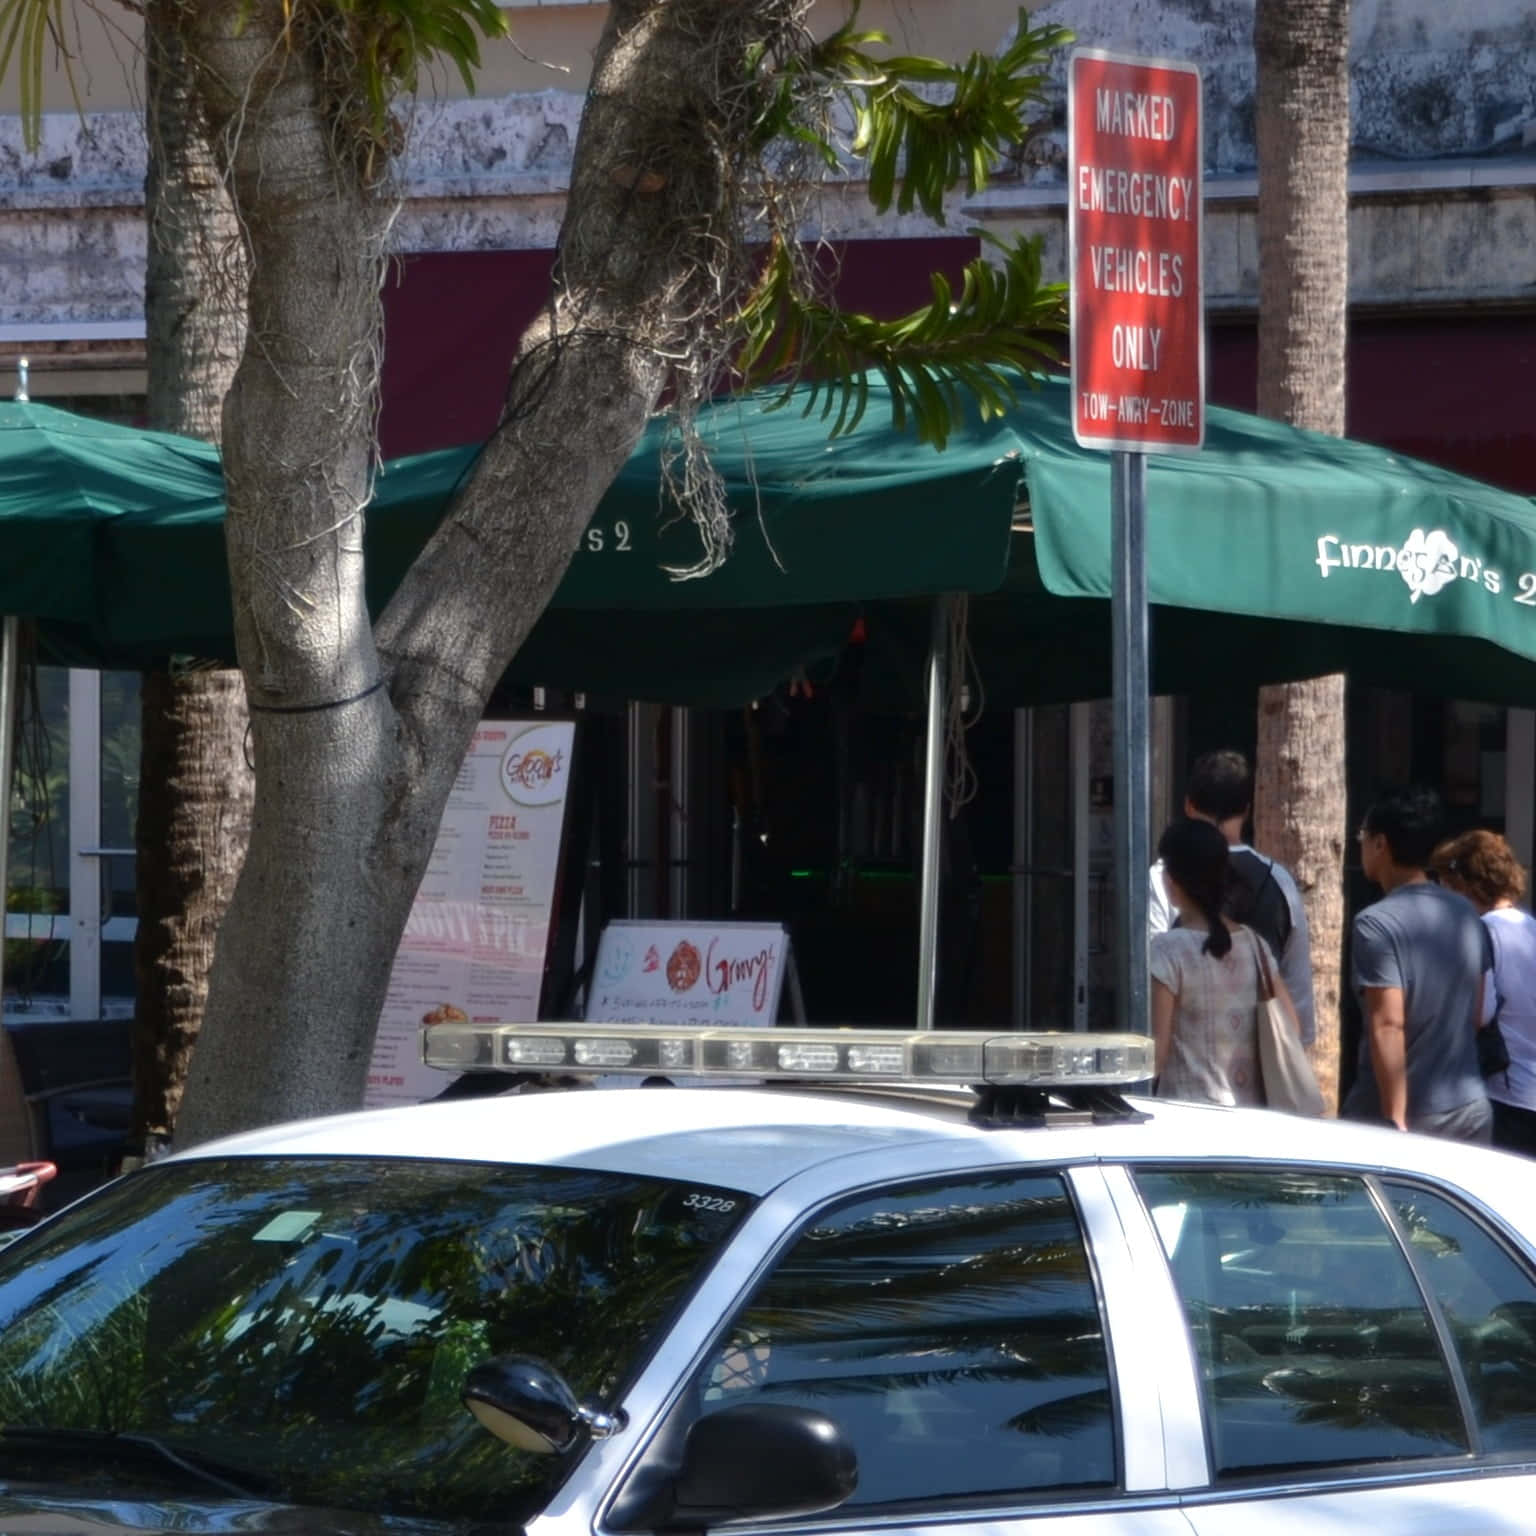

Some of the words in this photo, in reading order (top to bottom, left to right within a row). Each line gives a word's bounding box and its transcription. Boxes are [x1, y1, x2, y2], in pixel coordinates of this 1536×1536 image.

[1096, 87, 1176, 142] MARKED
[1078, 165, 1193, 222] EMERGENCY
[1090, 244, 1184, 298] VEHICLES
[1112, 324, 1161, 372] ONLY
[682, 1193, 736, 1213] 3328
